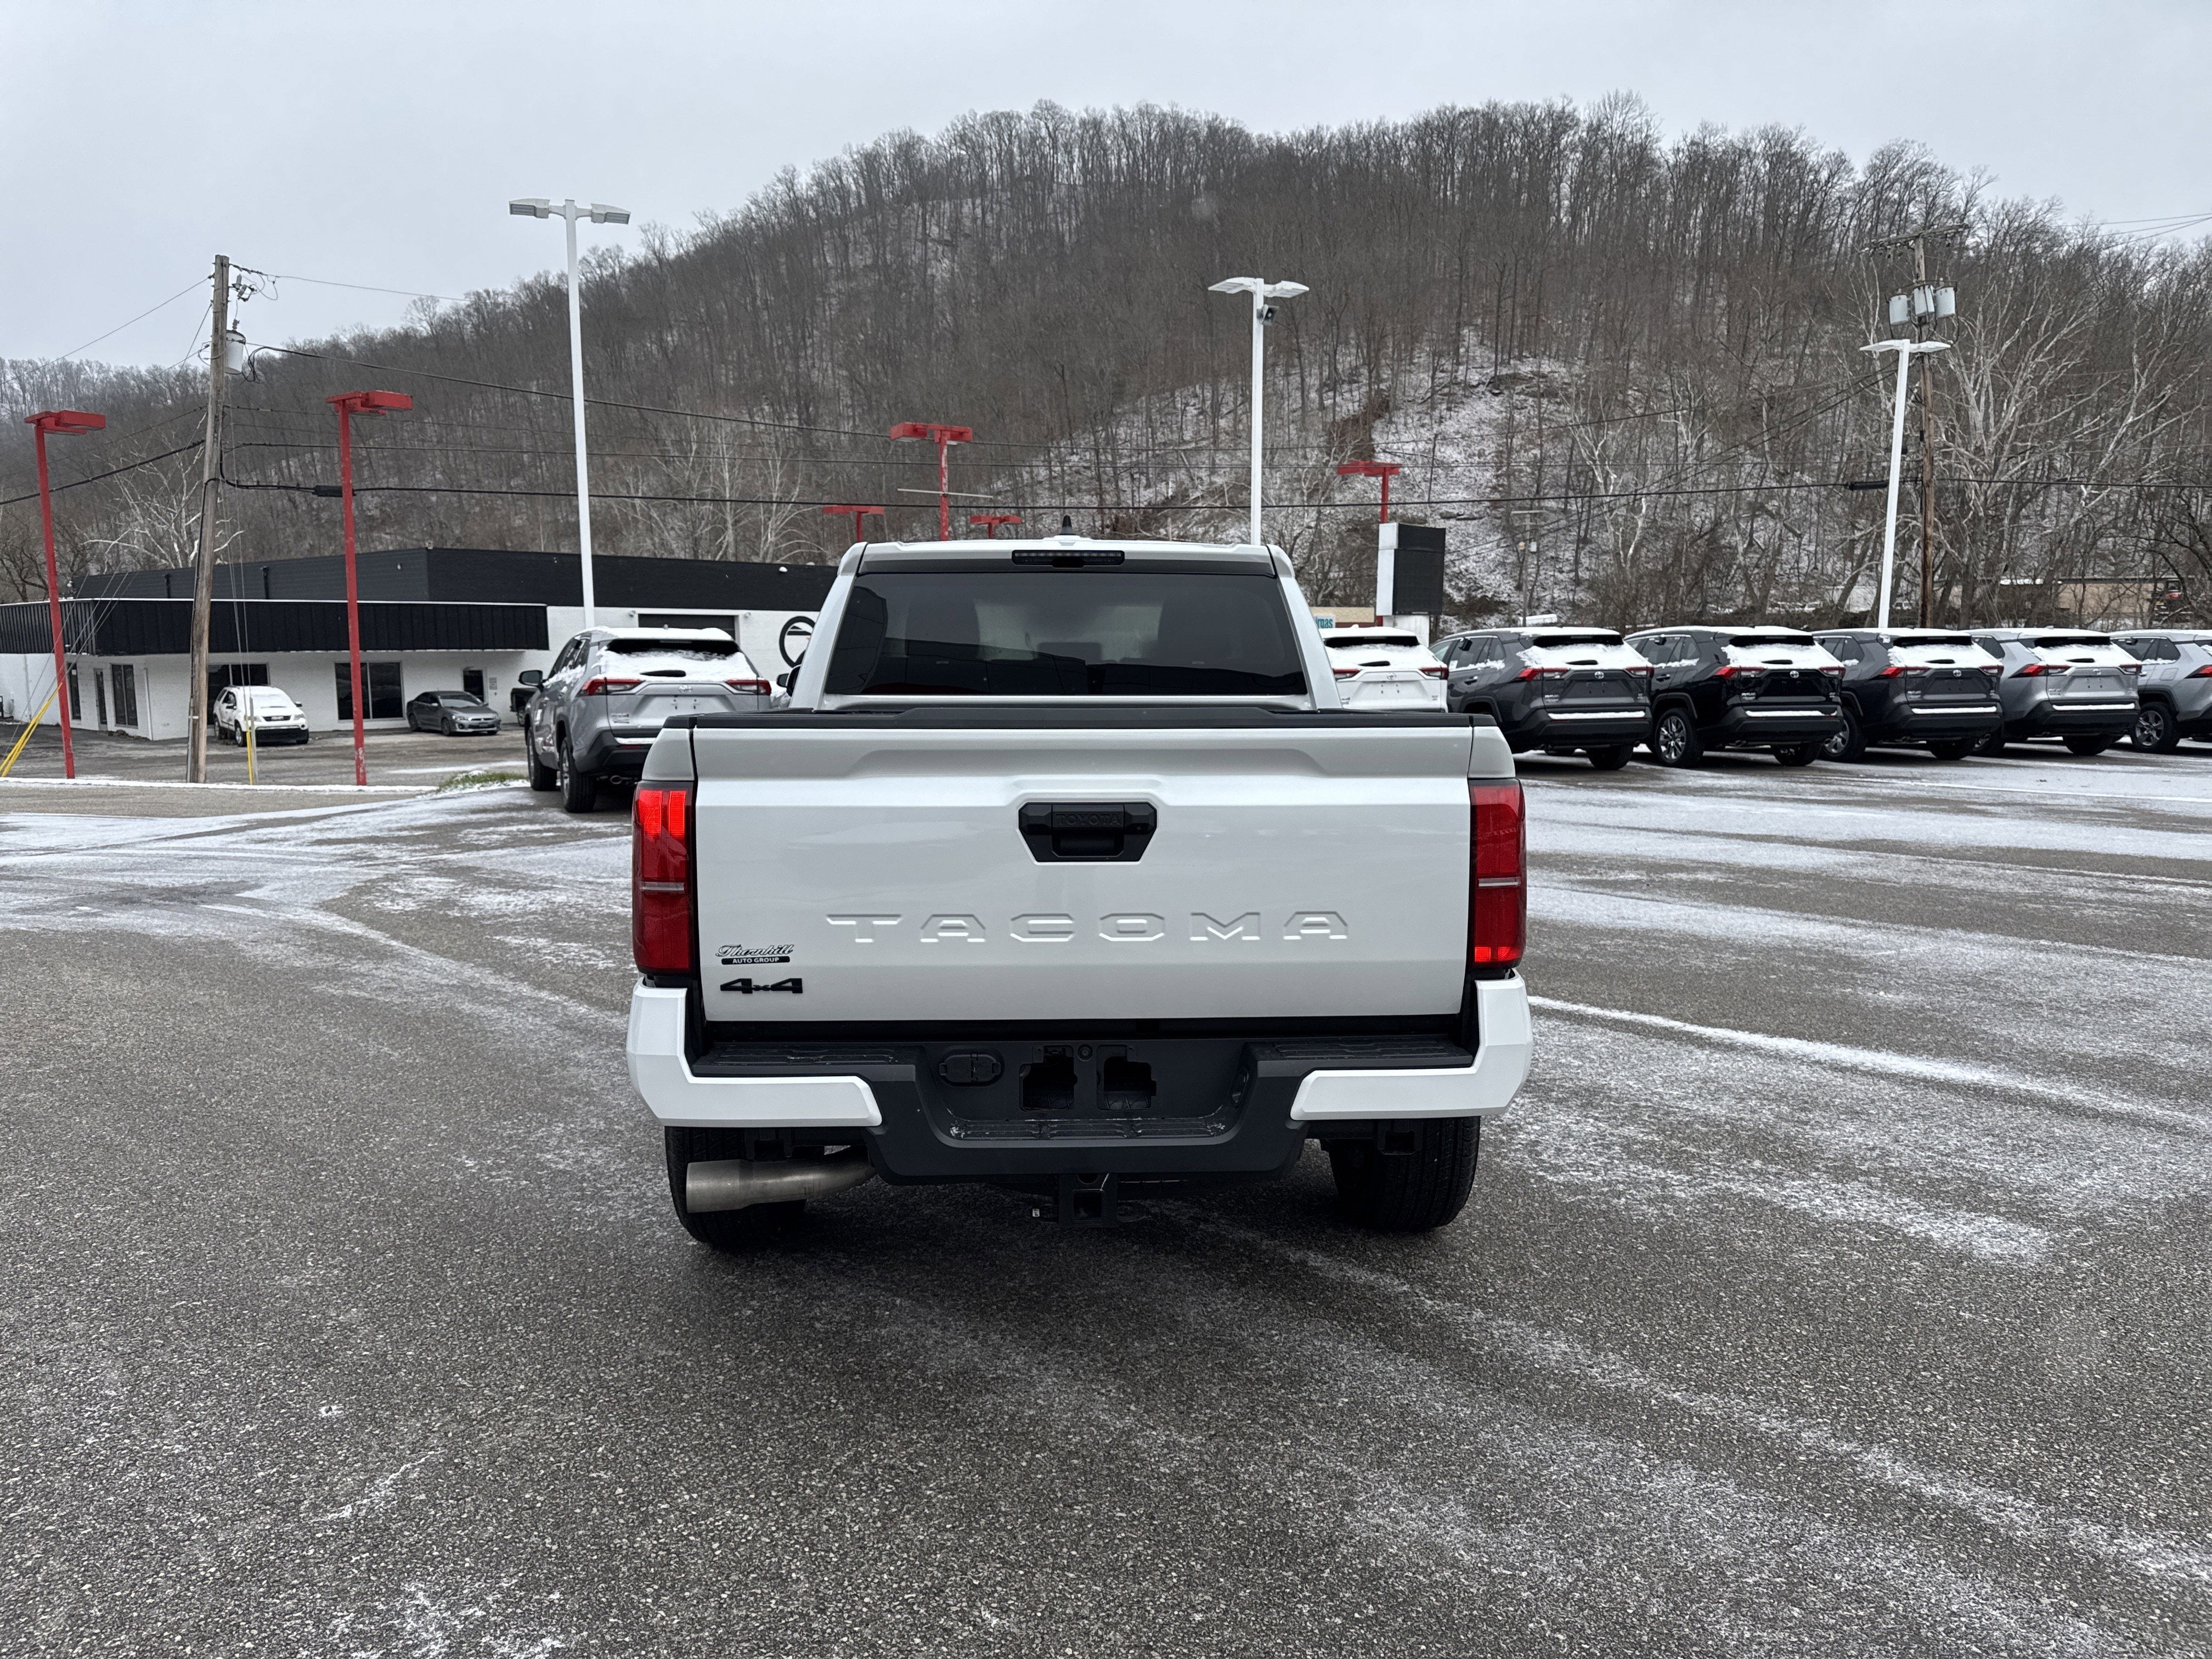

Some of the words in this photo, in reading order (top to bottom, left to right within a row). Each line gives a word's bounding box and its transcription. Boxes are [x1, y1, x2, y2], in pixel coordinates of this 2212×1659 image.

[1056, 814, 1121, 826] TOYOTA
[826, 911, 1348, 943] TACOMA
[715, 944, 794, 957] Thornhill
[720, 978, 803, 994] 4x4
